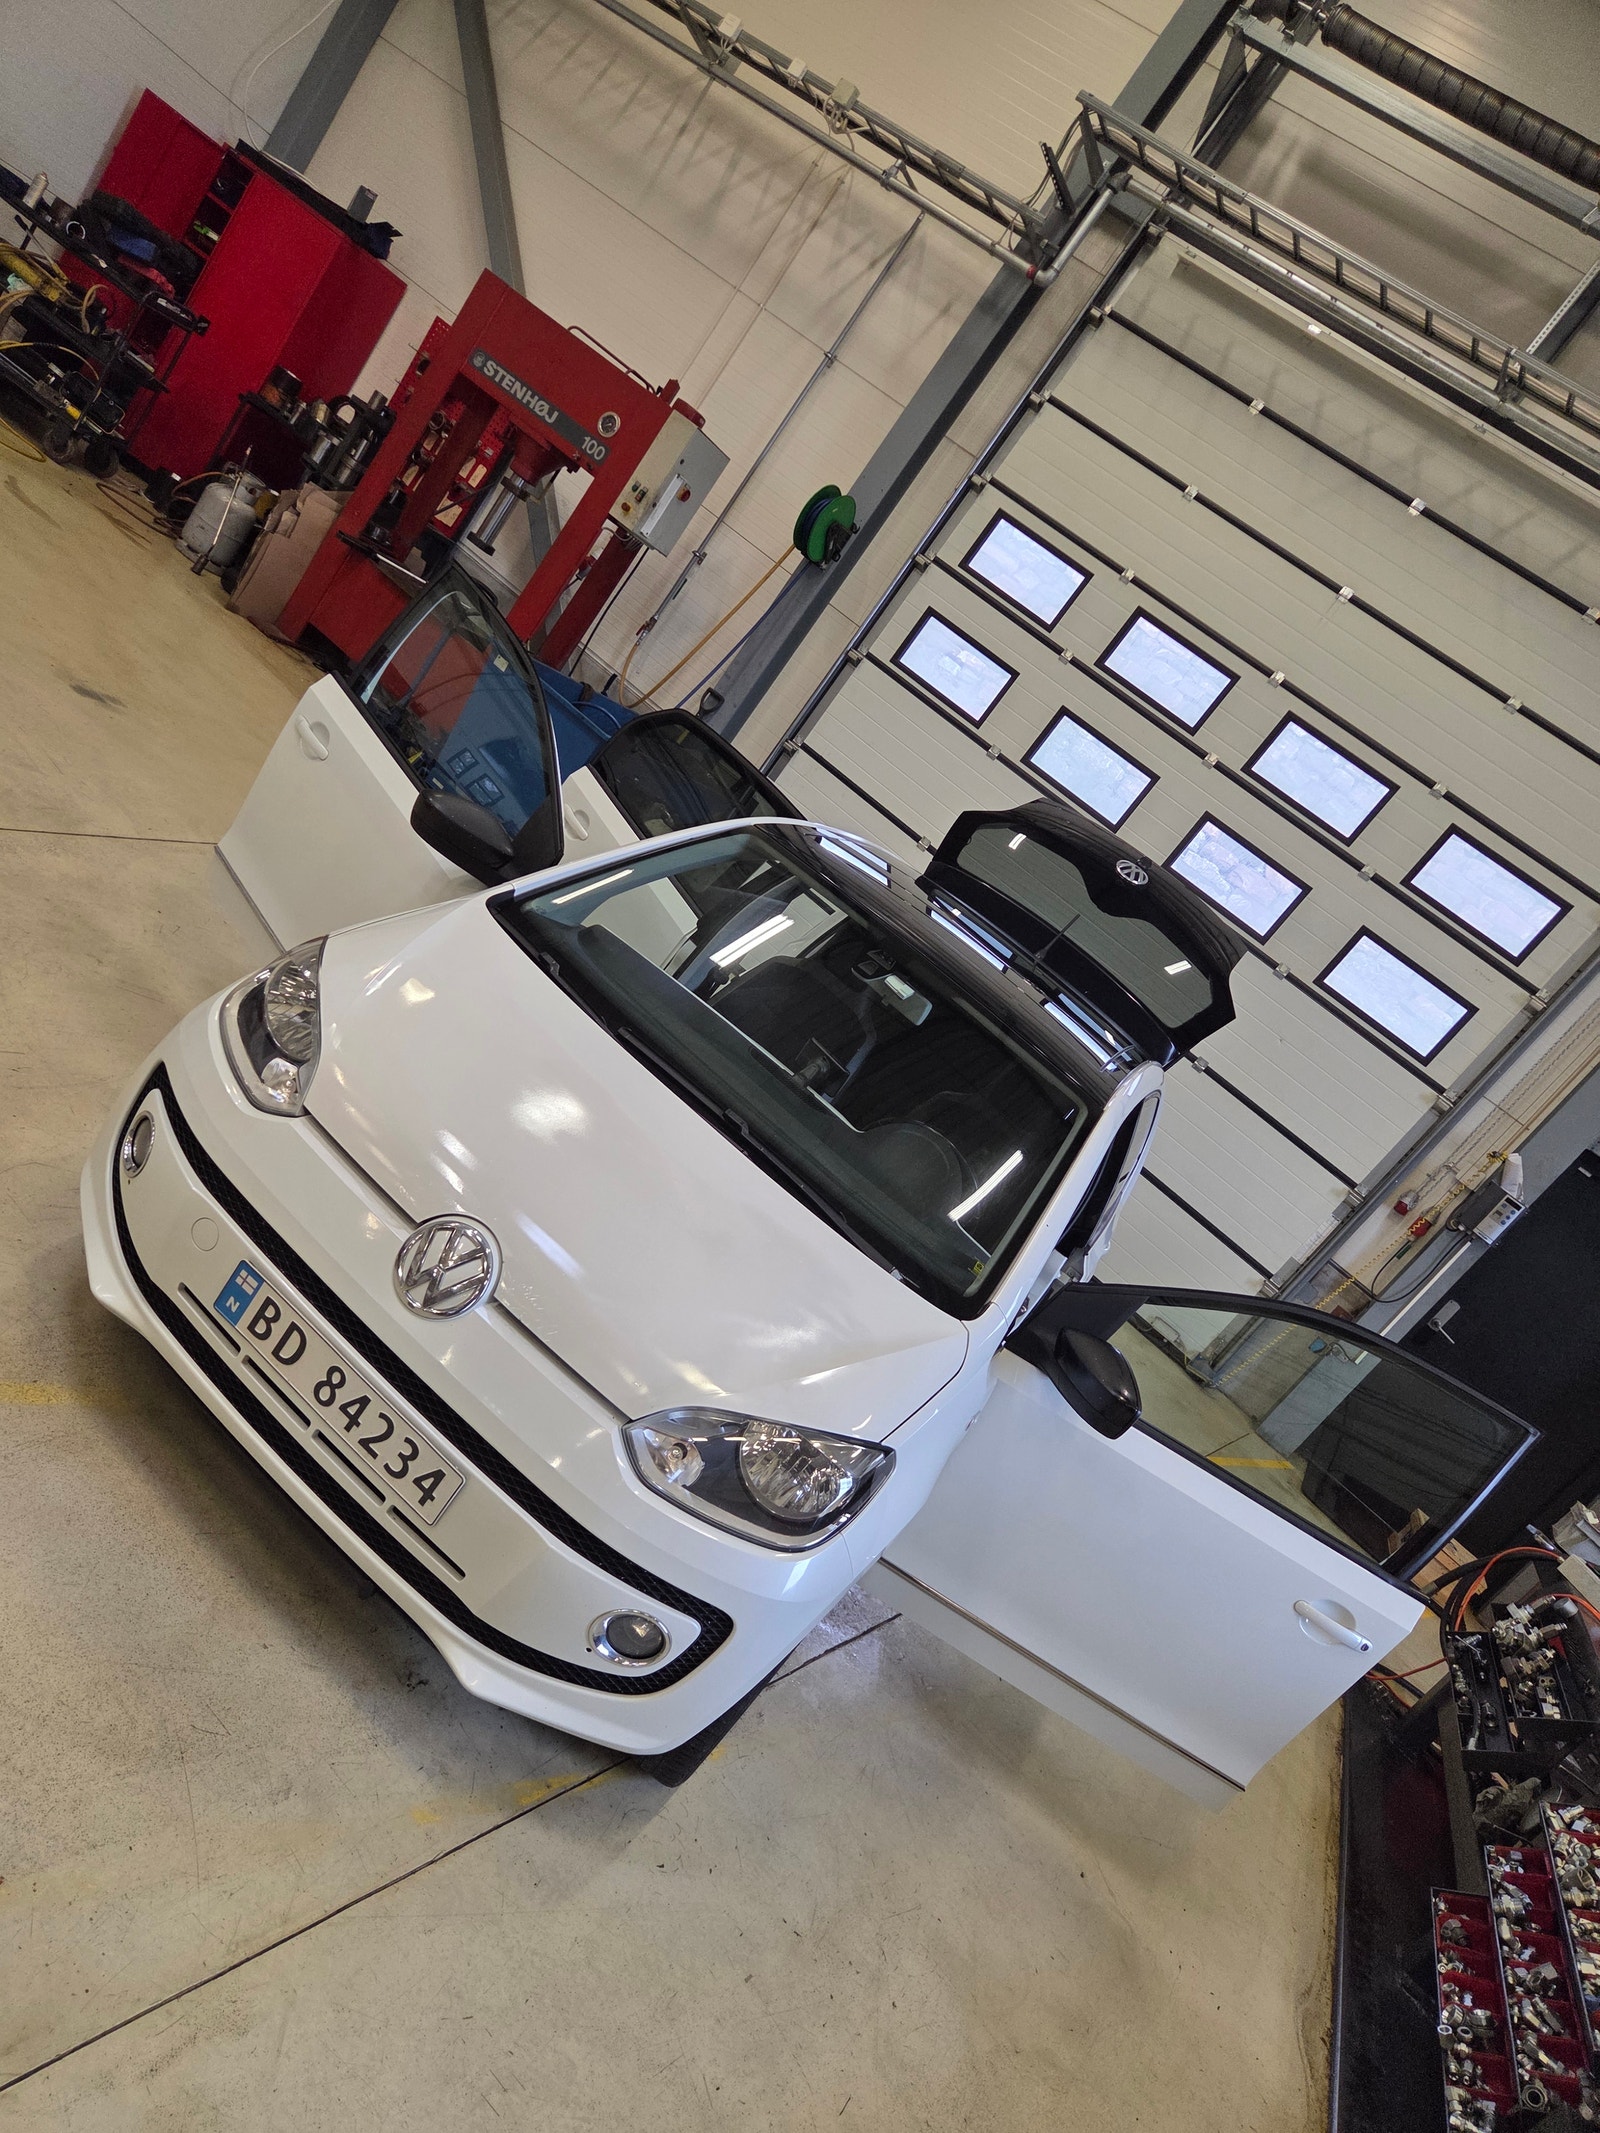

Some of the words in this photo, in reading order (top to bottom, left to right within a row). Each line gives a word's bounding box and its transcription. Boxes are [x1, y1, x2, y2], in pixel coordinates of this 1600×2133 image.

[483, 360, 559, 423] STENHØJ
[583, 436, 606, 461] 100
[226, 1295, 241, 1313] N
[246, 1295, 307, 1366] BD
[313, 1365, 447, 1507] 84234
